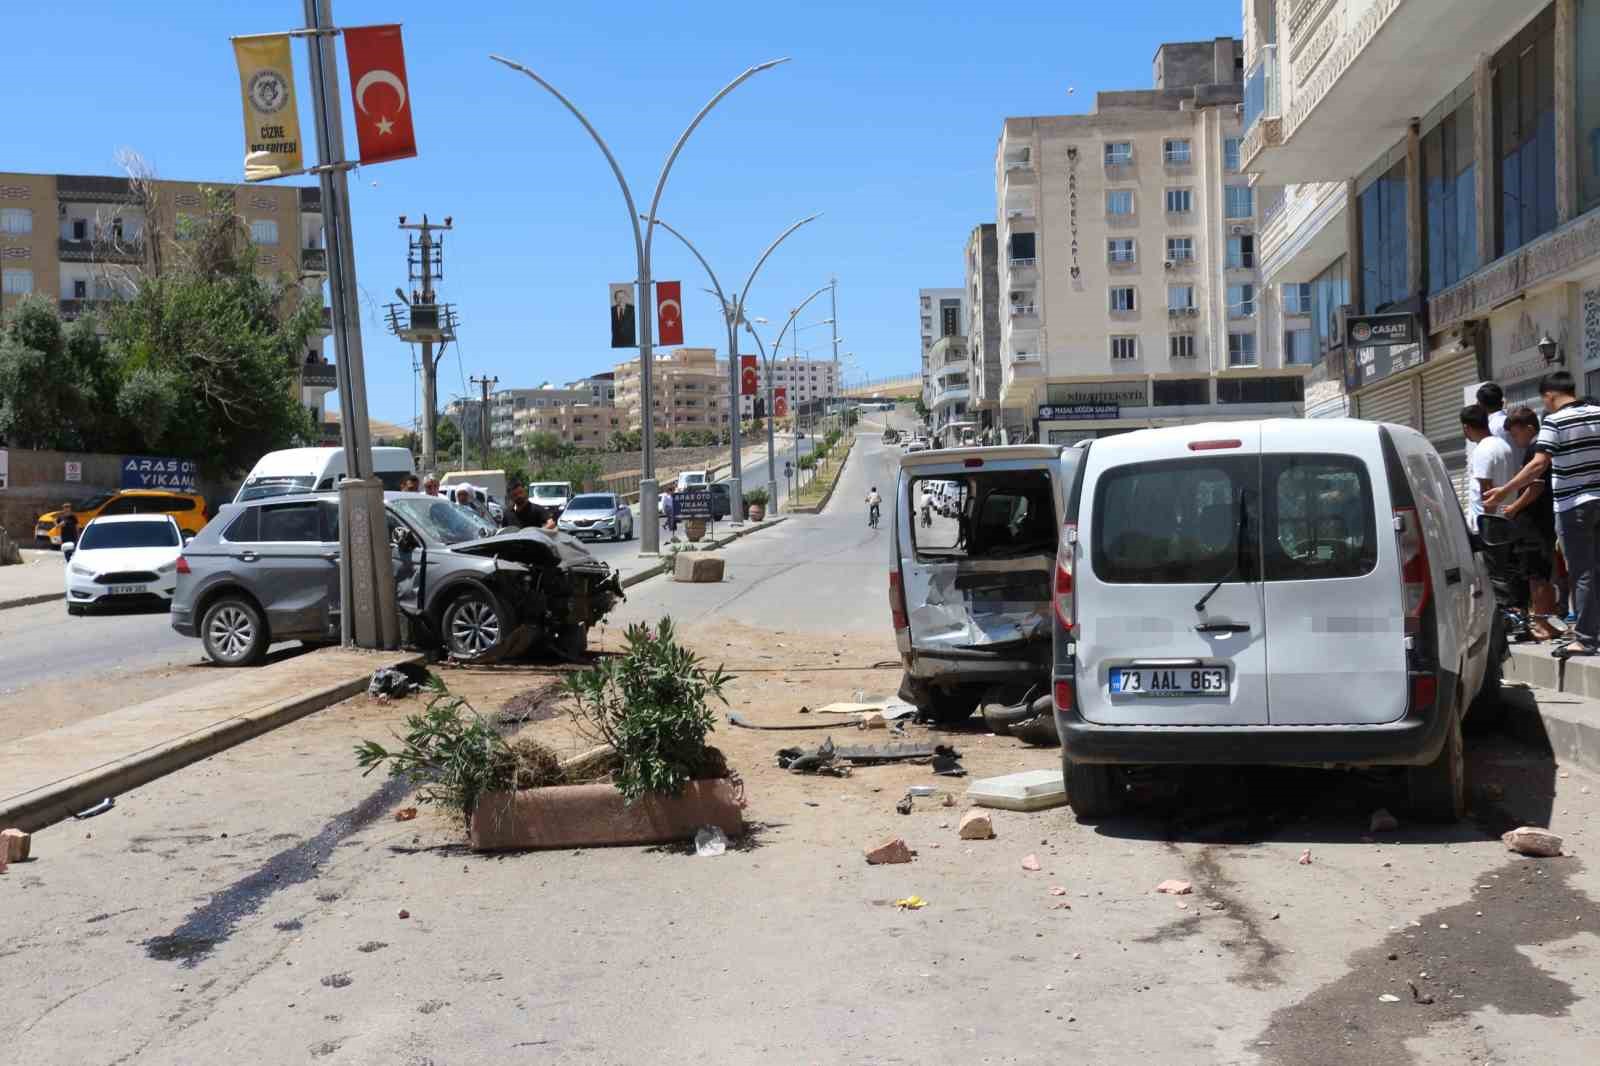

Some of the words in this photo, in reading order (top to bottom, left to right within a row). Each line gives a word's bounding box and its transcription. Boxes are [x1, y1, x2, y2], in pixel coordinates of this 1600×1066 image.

[125, 459, 177, 472] ARAS
[1121, 671, 1141, 690] 73
[1151, 671, 1181, 690] AAL
[1191, 670, 1222, 690] 863
